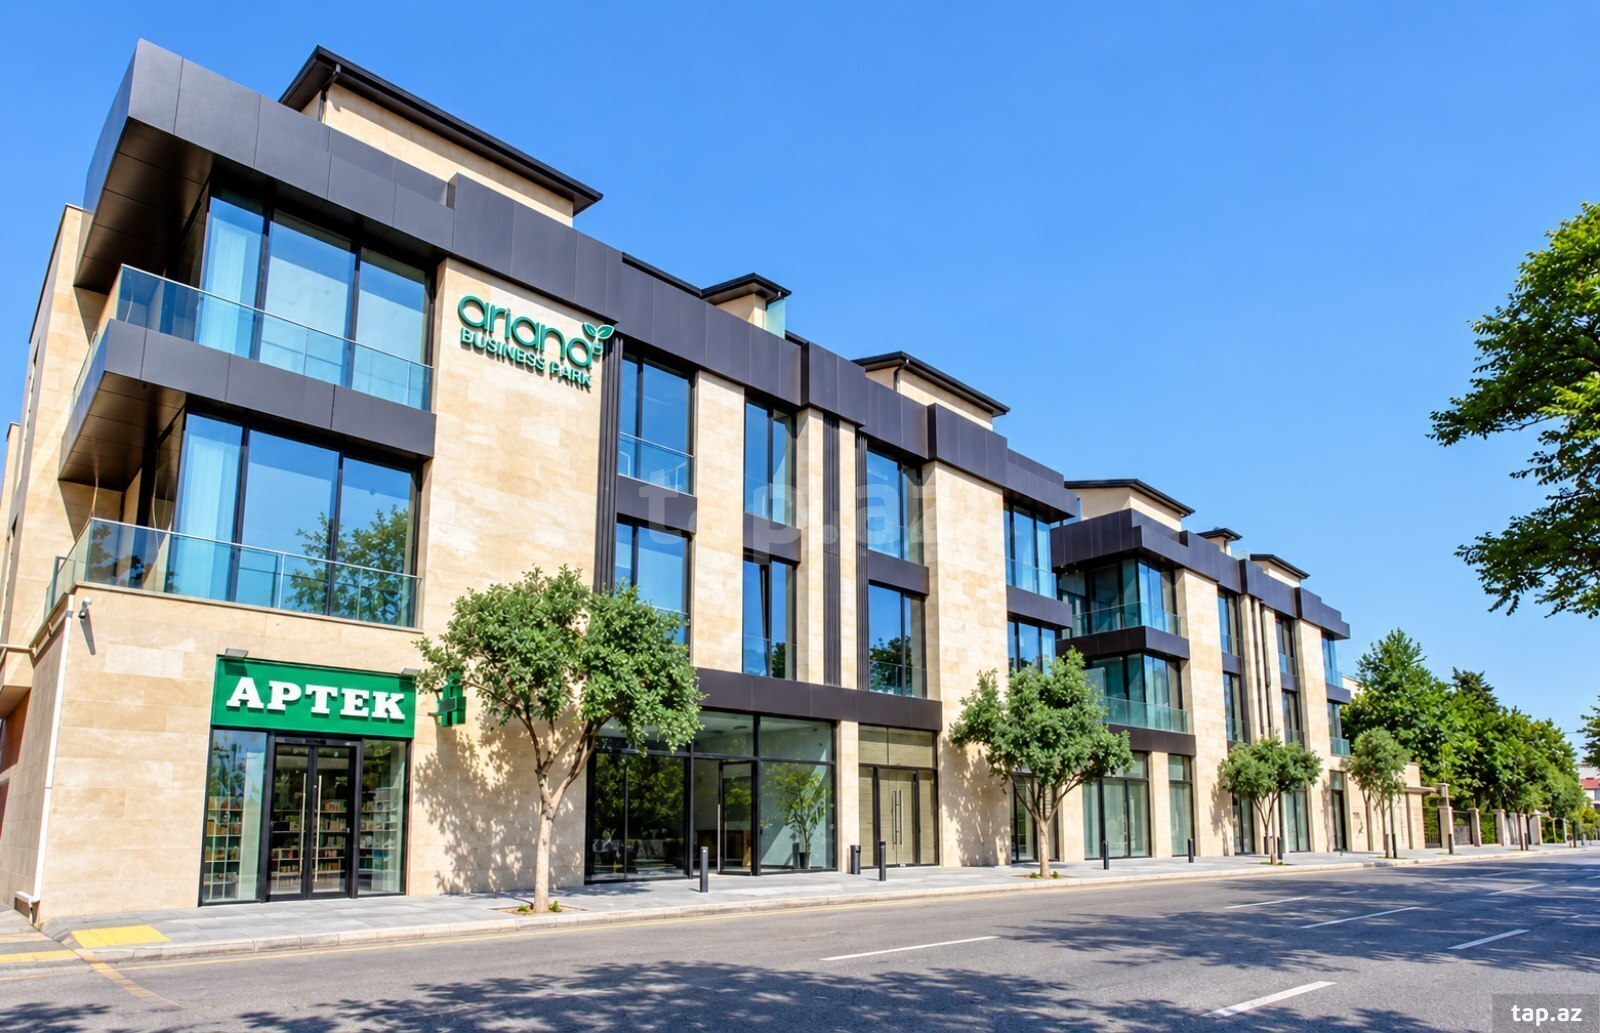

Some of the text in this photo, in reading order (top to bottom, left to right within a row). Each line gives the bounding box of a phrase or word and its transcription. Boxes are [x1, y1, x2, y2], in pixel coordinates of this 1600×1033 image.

[458, 295, 593, 369] ariana
[460, 327, 592, 388] BUSINESS PARK
[226, 676, 405, 721] APTEK
